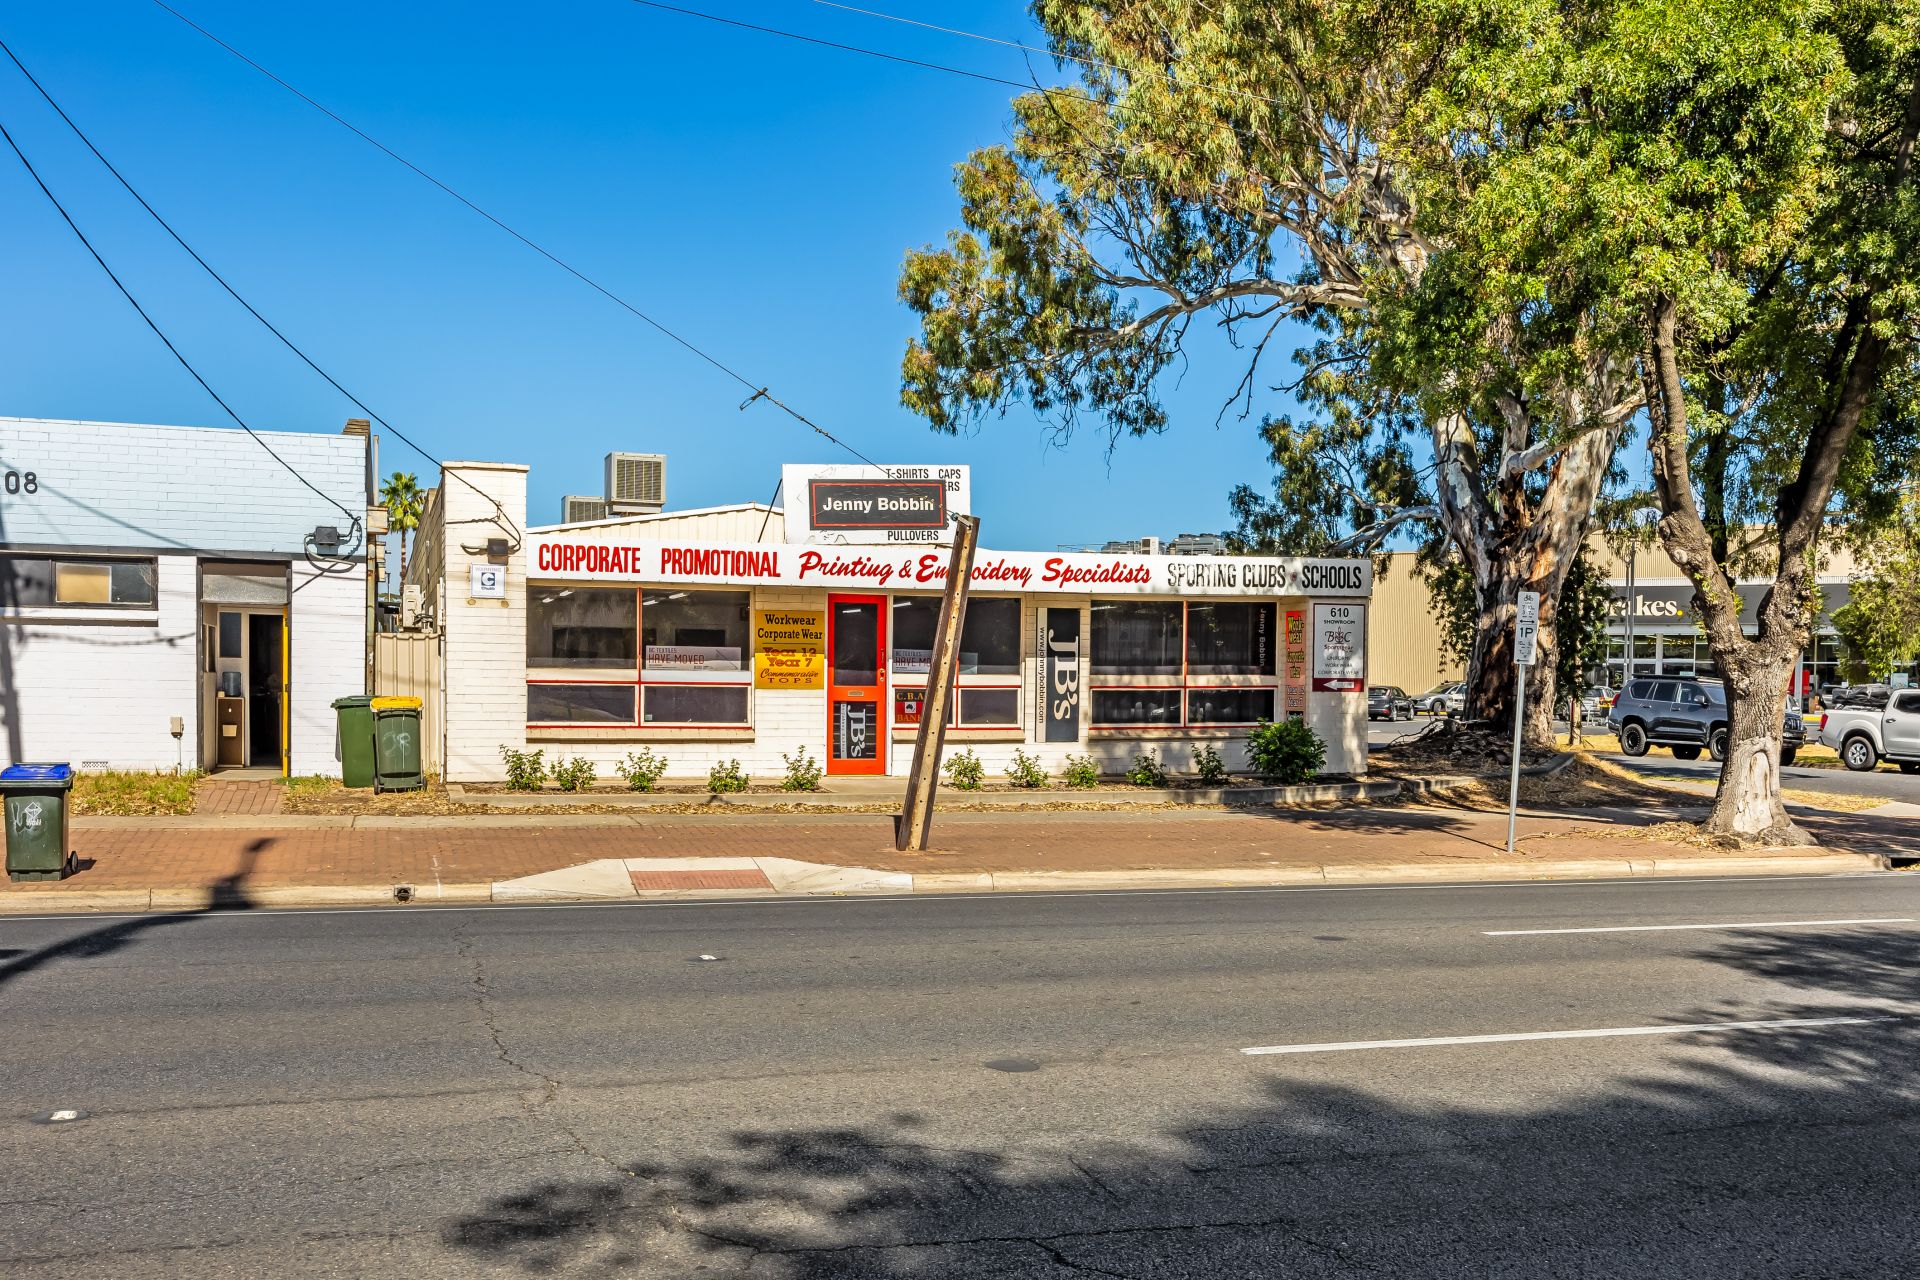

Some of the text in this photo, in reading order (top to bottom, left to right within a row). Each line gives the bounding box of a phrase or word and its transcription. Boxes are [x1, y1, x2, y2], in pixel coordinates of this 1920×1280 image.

[886, 468, 961, 479] T-SHIRTS CAPS
[5, 471, 38, 494] 08
[823, 497, 935, 513] Jenny Bobbin
[887, 530, 939, 541] PULLOVERS
[538, 543, 781, 578] CORPORATE PROMOTIONAL
[799, 551, 1152, 588] Printing & Emoidery Specialists
[1167, 562, 1362, 589] SPORTING CLUBS SCHOOLS
[1330, 607, 1349, 618] 610
[765, 613, 817, 626] Workwear
[1259, 608, 1267, 634] Jenny
[757, 627, 823, 642] Corporate Wear
[1520, 627, 1534, 638] 1P
[762, 646, 817, 657] Year 12
[649, 654, 704, 665] HAVE MOVED
[766, 657, 813, 667] Year 7
[896, 657, 917, 667] HAVE
[760, 668, 819, 679] Commemorative
[1048, 628, 1079, 720] JB's
[847, 704, 865, 757] JB's
